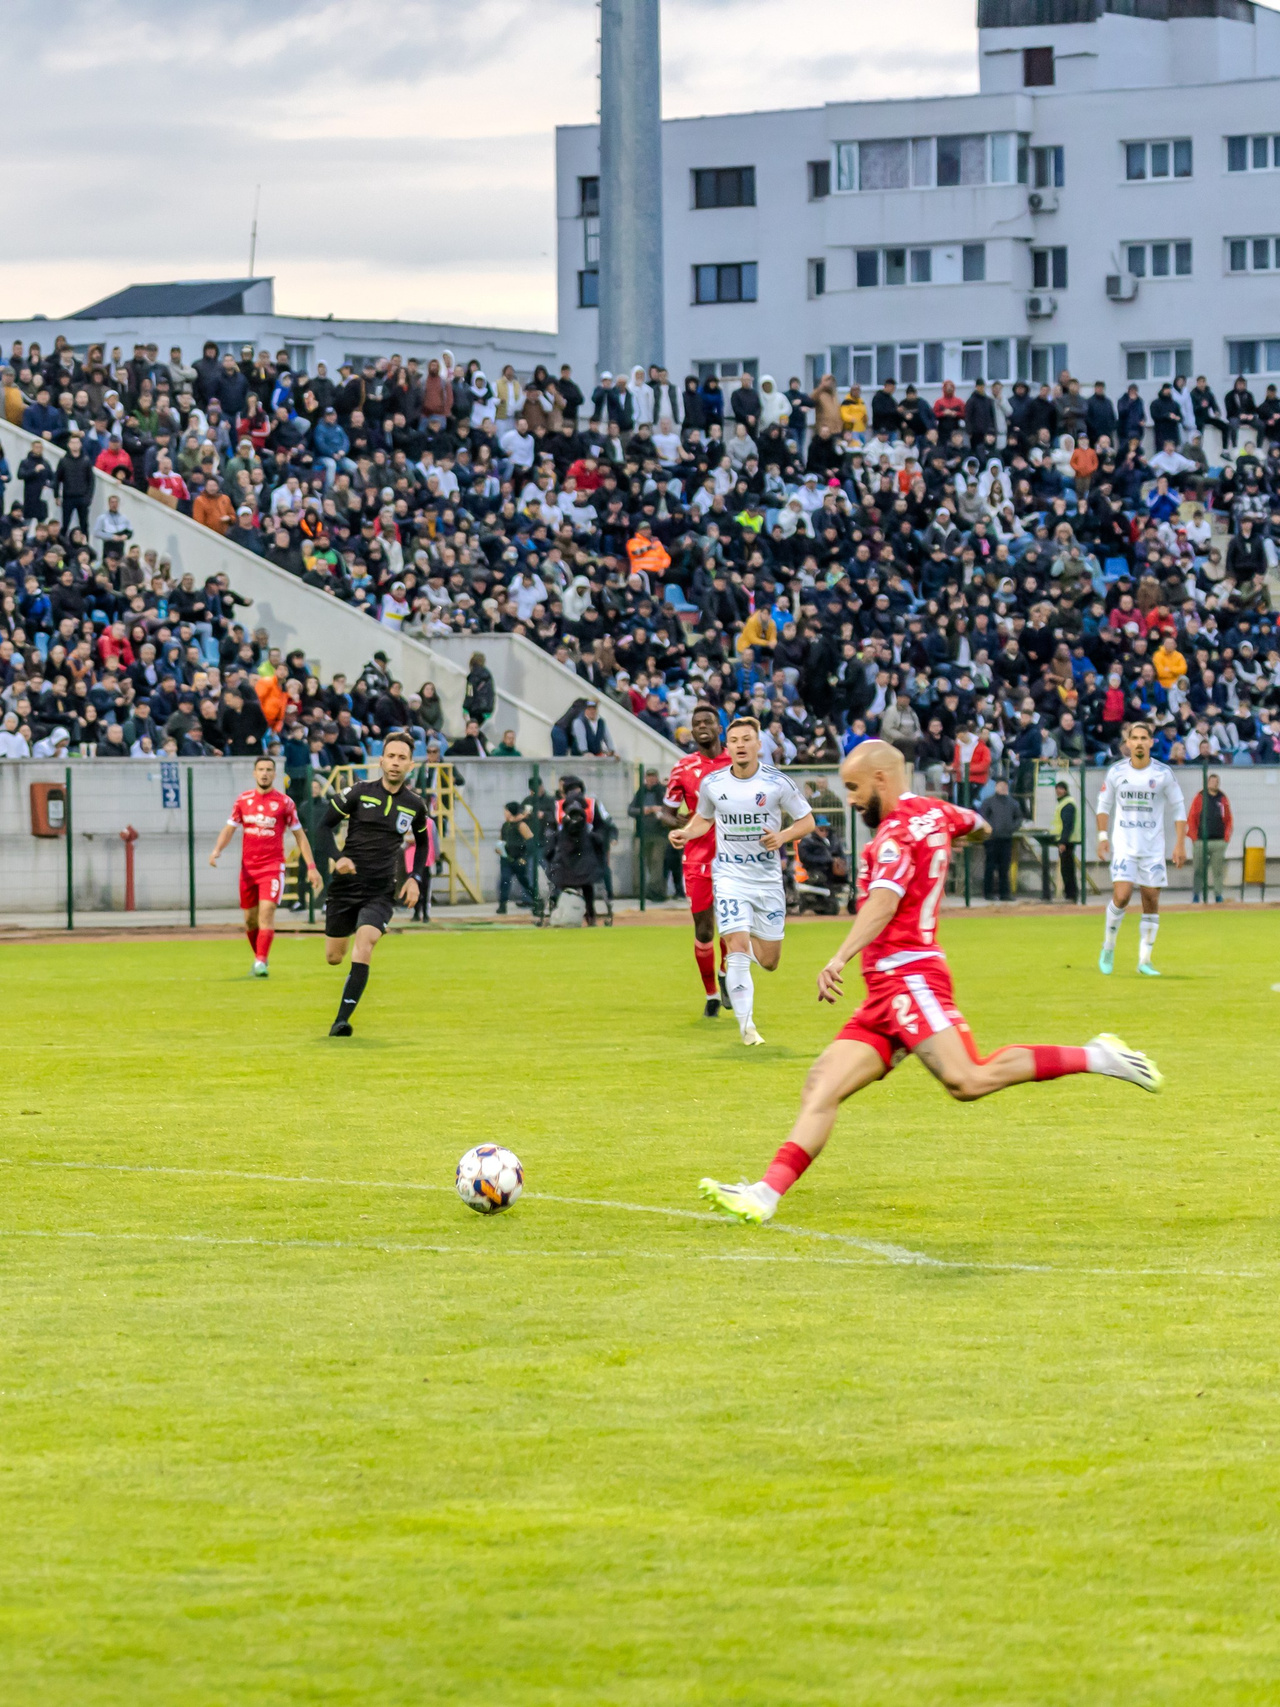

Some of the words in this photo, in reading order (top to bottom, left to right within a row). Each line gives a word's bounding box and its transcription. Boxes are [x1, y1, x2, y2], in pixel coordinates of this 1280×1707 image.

[1120, 791, 1157, 800] UNIBET
[722, 813, 770, 825] UNIBET
[1120, 820, 1156, 829] ELSACO
[719, 850, 775, 864] ELSACO
[720, 899, 739, 918] 33
[891, 994, 919, 1026] 2
